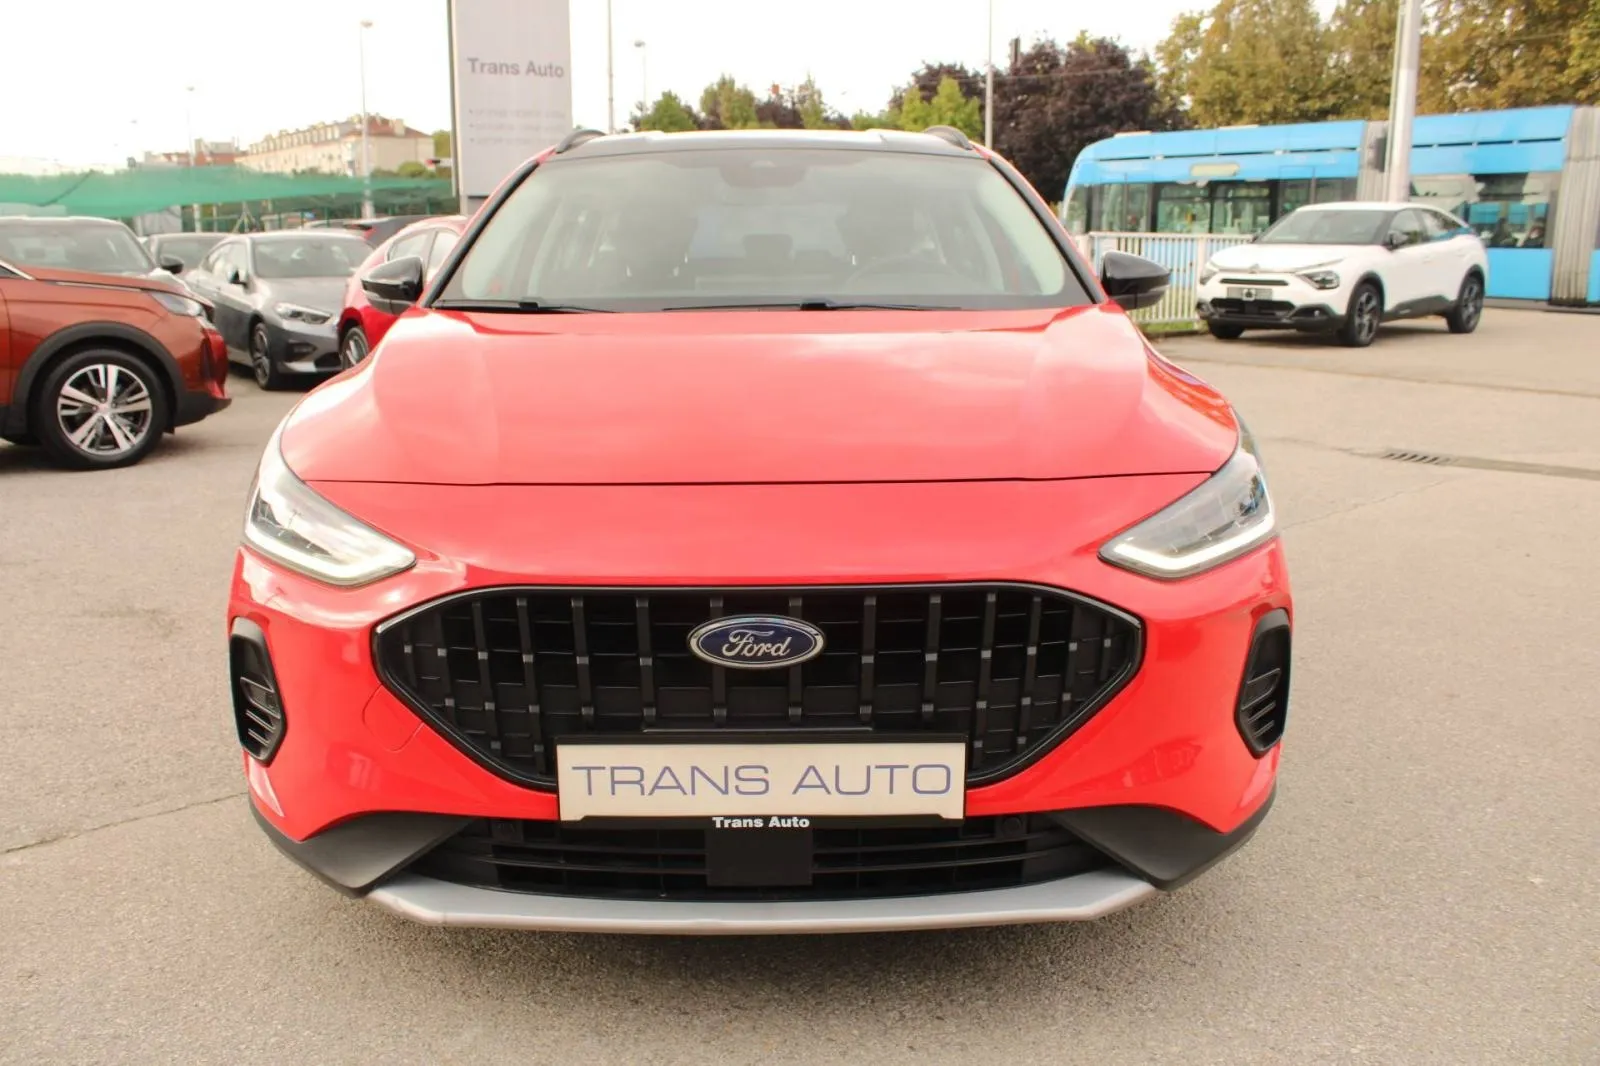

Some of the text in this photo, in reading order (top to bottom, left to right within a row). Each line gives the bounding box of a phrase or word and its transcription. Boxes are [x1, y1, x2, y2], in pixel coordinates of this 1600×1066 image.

[467, 57, 565, 79] Trans Auto
[721, 628, 791, 658] Ford
[571, 763, 953, 797] TRANS AUTO
[711, 816, 811, 829] Trans Auto
